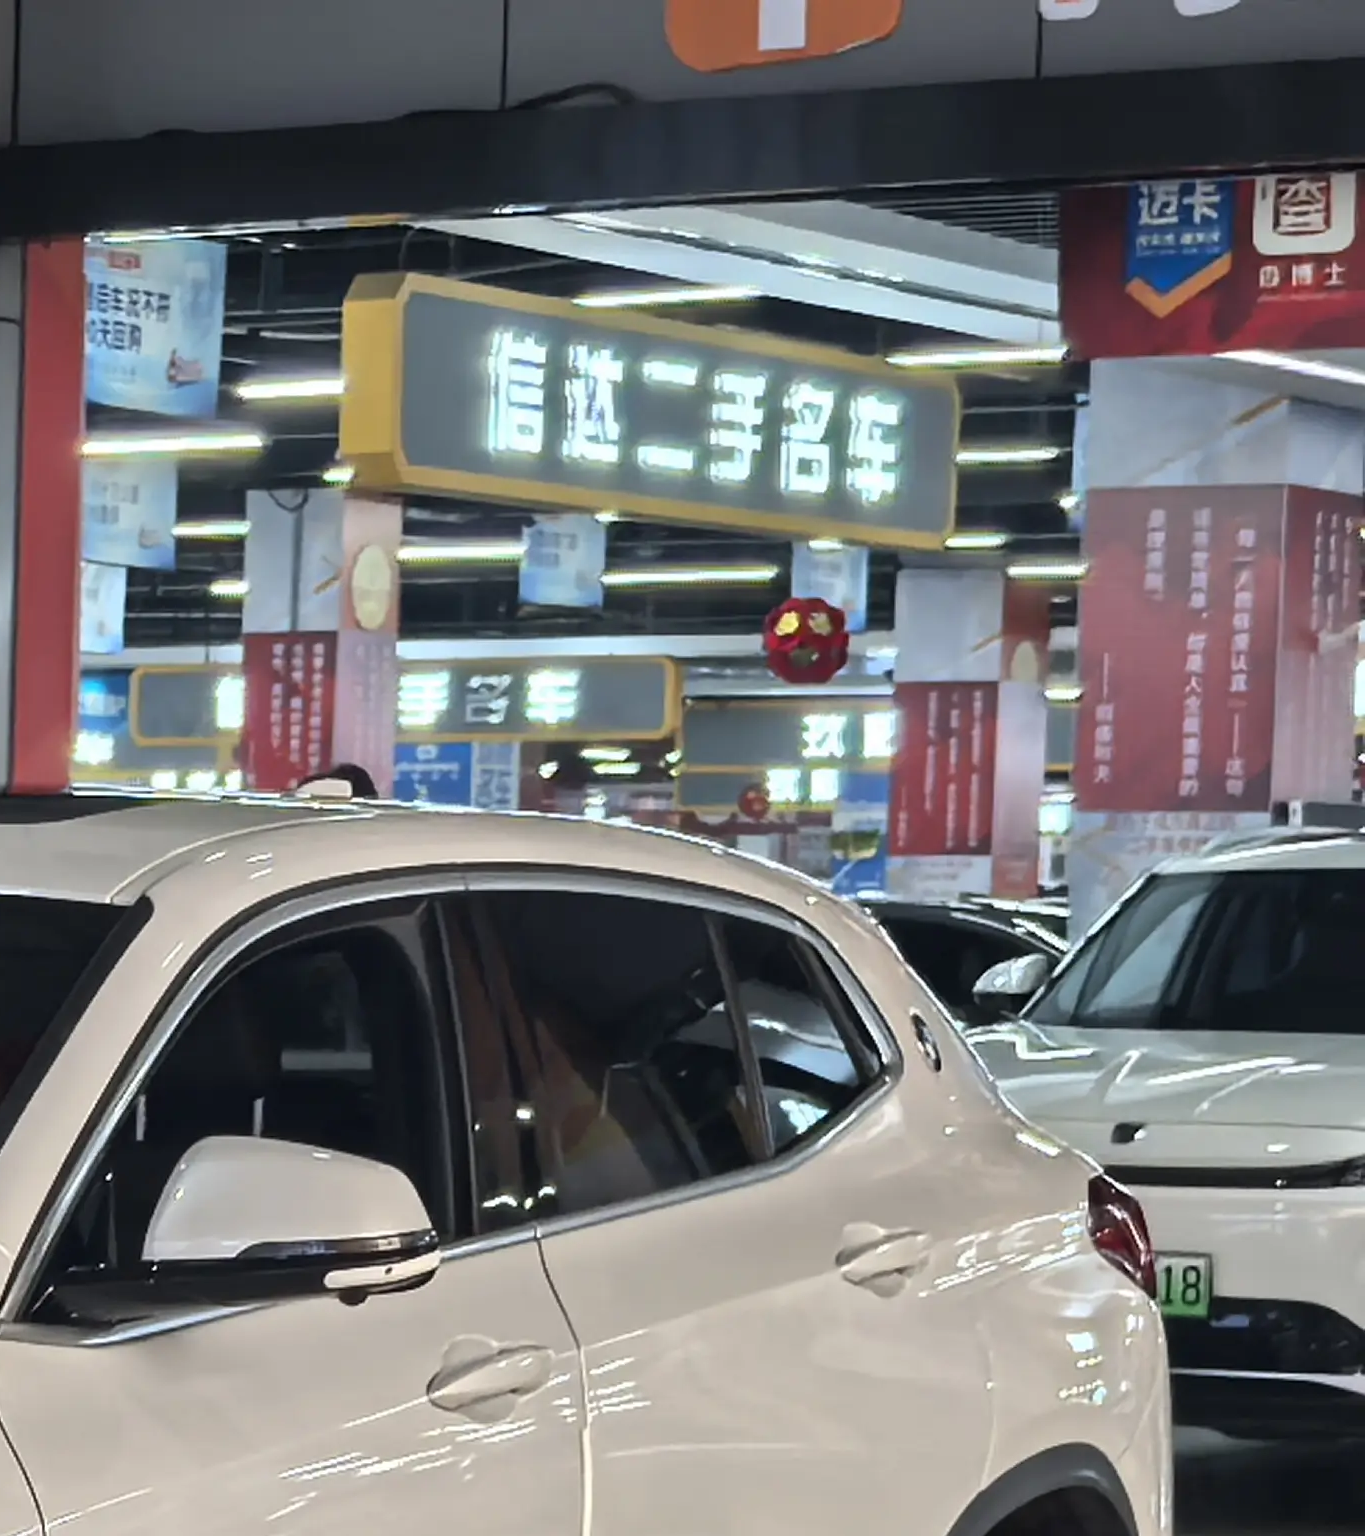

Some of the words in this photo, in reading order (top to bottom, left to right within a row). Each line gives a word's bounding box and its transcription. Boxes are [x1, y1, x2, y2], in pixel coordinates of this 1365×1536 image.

[488, 330, 906, 504] 信达二手名车
[1161, 1265, 1201, 1306] 18
